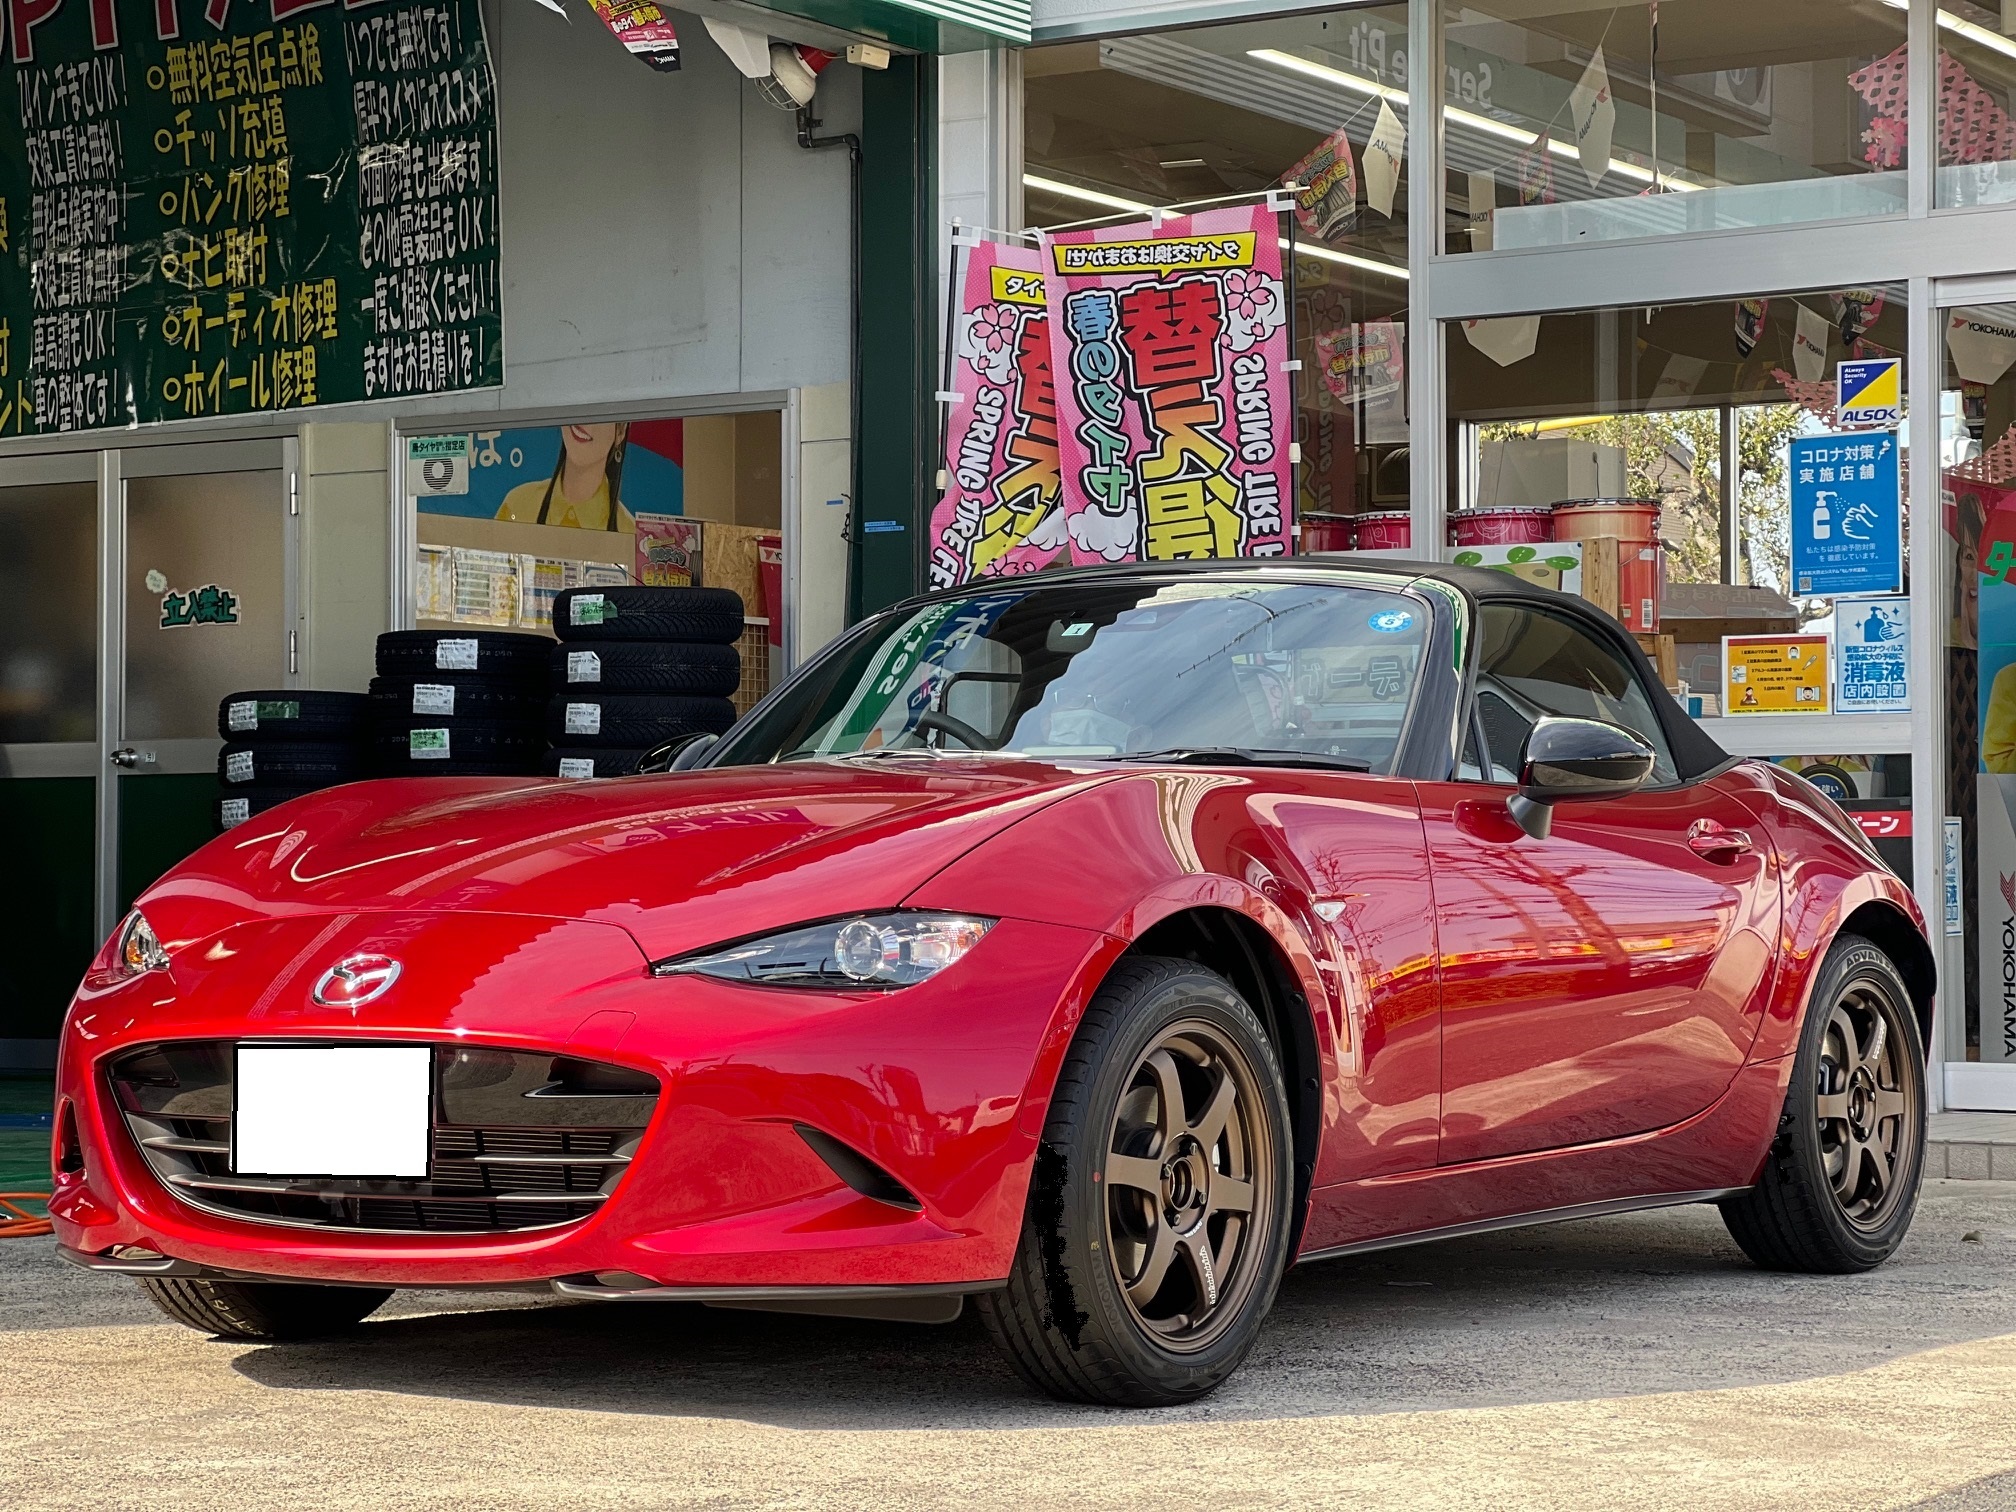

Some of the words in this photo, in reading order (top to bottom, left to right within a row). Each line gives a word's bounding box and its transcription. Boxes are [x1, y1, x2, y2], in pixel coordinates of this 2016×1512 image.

[166, 22, 323, 105] 無料空気圧点検
[26, 119, 124, 188] 交換工賃は無料!
[175, 94, 287, 166] チッソ充填
[182, 158, 290, 225] パンク修理
[182, 223, 268, 290] ナビ取付
[360, 195, 495, 269] その他電装品もOK!
[33, 308, 116, 373] 車高調もOK!
[183, 278, 338, 351] オーディオ修理
[34, 369, 118, 433] 車の整体です!
[184, 345, 317, 415] ホイール修理
[958, 385, 998, 491] SPRING
[1842, 409, 1897, 422] ALSOK
[1800, 463, 1874, 484] 実施店舗
[1801, 445, 1874, 463] コロナ対策
[941, 494, 980, 555] TIRE
[161, 585, 238, 628] 立入禁止
[1844, 661, 1905, 683] 消毒液
[1844, 683, 1906, 698] 店内設置
[1818, 784, 1839, 794] 強い
[1846, 950, 1884, 970] ADVAN
